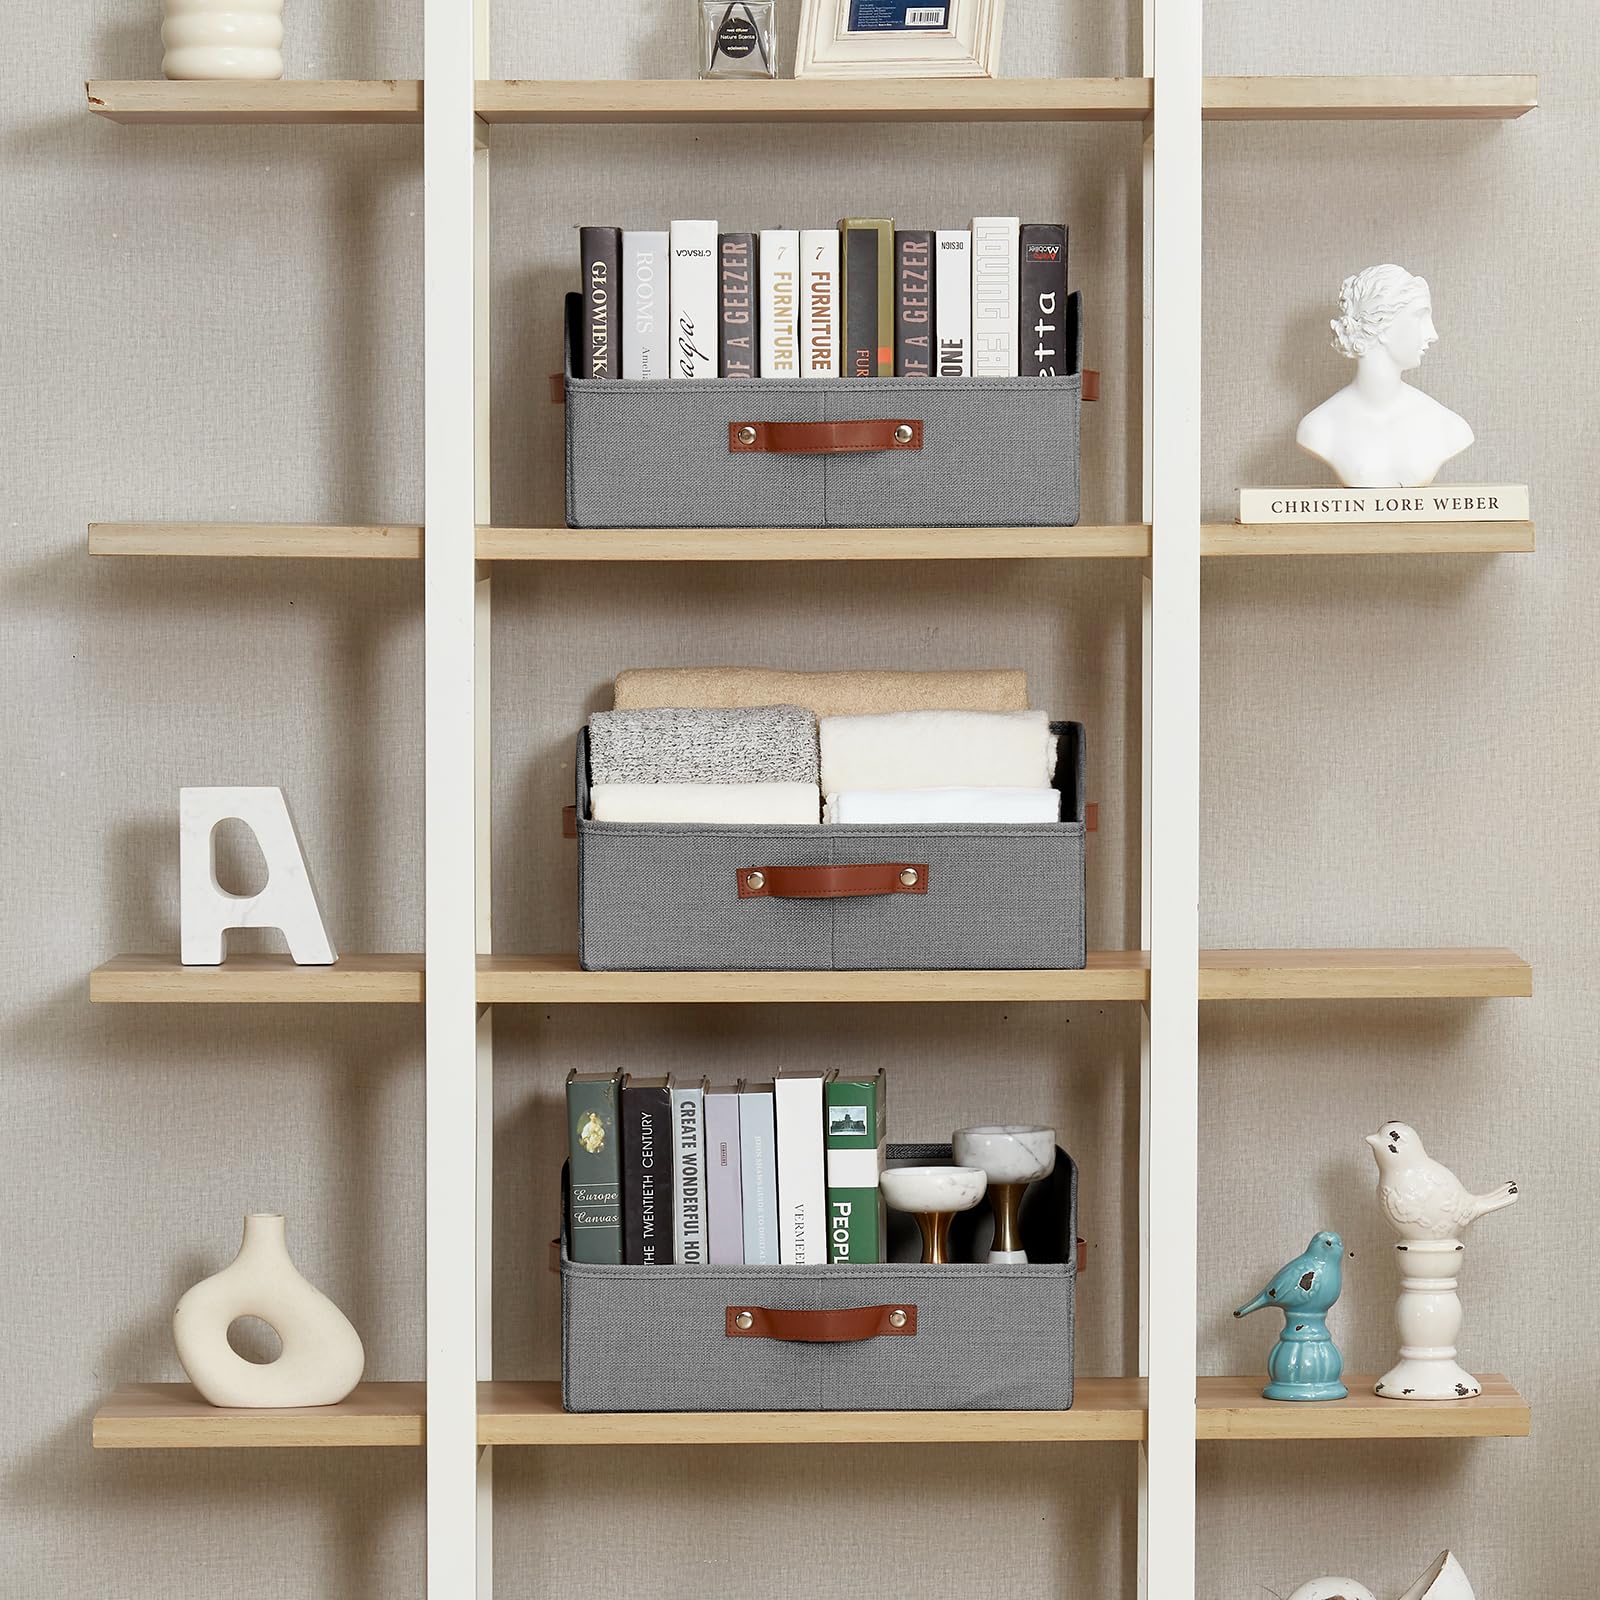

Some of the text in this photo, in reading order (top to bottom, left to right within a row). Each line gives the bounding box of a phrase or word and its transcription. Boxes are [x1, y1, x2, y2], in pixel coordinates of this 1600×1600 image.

[777, 246, 787, 260] 7
[815, 246, 825, 260] 7
[941, 241, 964, 250] DESIGN
[635, 251, 655, 335] ROOMS
[722, 242, 749, 325] GEEZER
[902, 241, 929, 323] GEEZER
[772, 271, 793, 371] FURNITURE
[811, 271, 832, 371] FURNITURE
[726, 336, 750, 348] A
[904, 335, 928, 347] A
[940, 338, 963, 377] ONE
[1271, 496, 1500, 514] CHRISTIN LORE WEBER
[679, 1100, 697, 1149] CREATE
[573, 1188, 619, 1205] Europe
[641, 1111, 655, 1265] THE TWENTIETH CENTURY
[681, 1152, 700, 1237] WONDERFUL
[573, 1210, 620, 1224] Canvas
